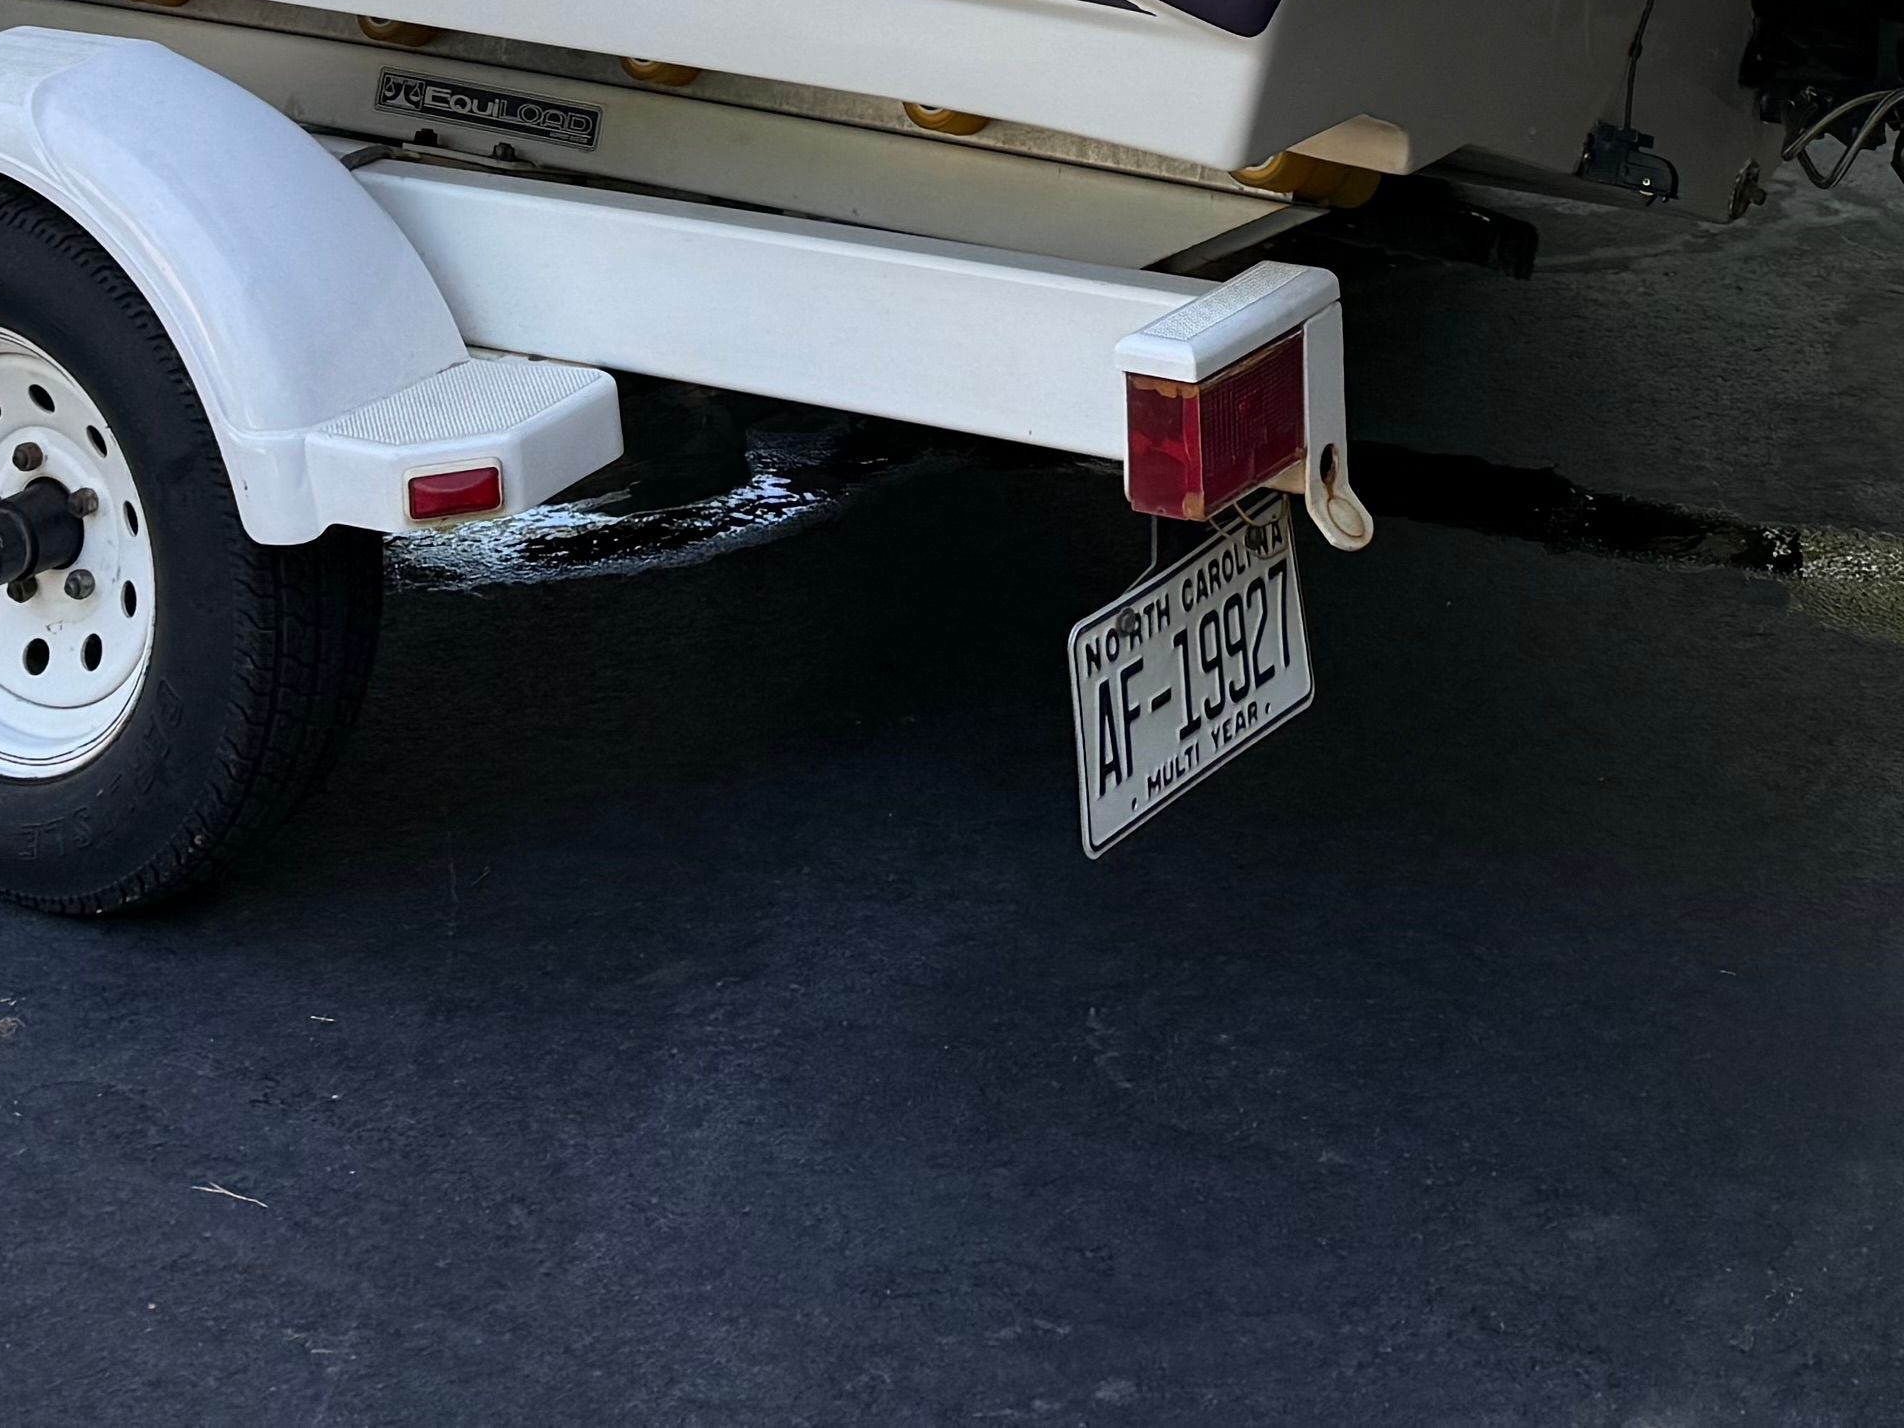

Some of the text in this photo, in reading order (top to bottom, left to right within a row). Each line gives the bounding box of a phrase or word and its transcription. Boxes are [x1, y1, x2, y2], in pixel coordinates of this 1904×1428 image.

[1086, 520, 1283, 676] NORTH CAROLINA
[1098, 558, 1291, 799] AF-19927
[1147, 701, 1259, 799] MULTI YEAR
